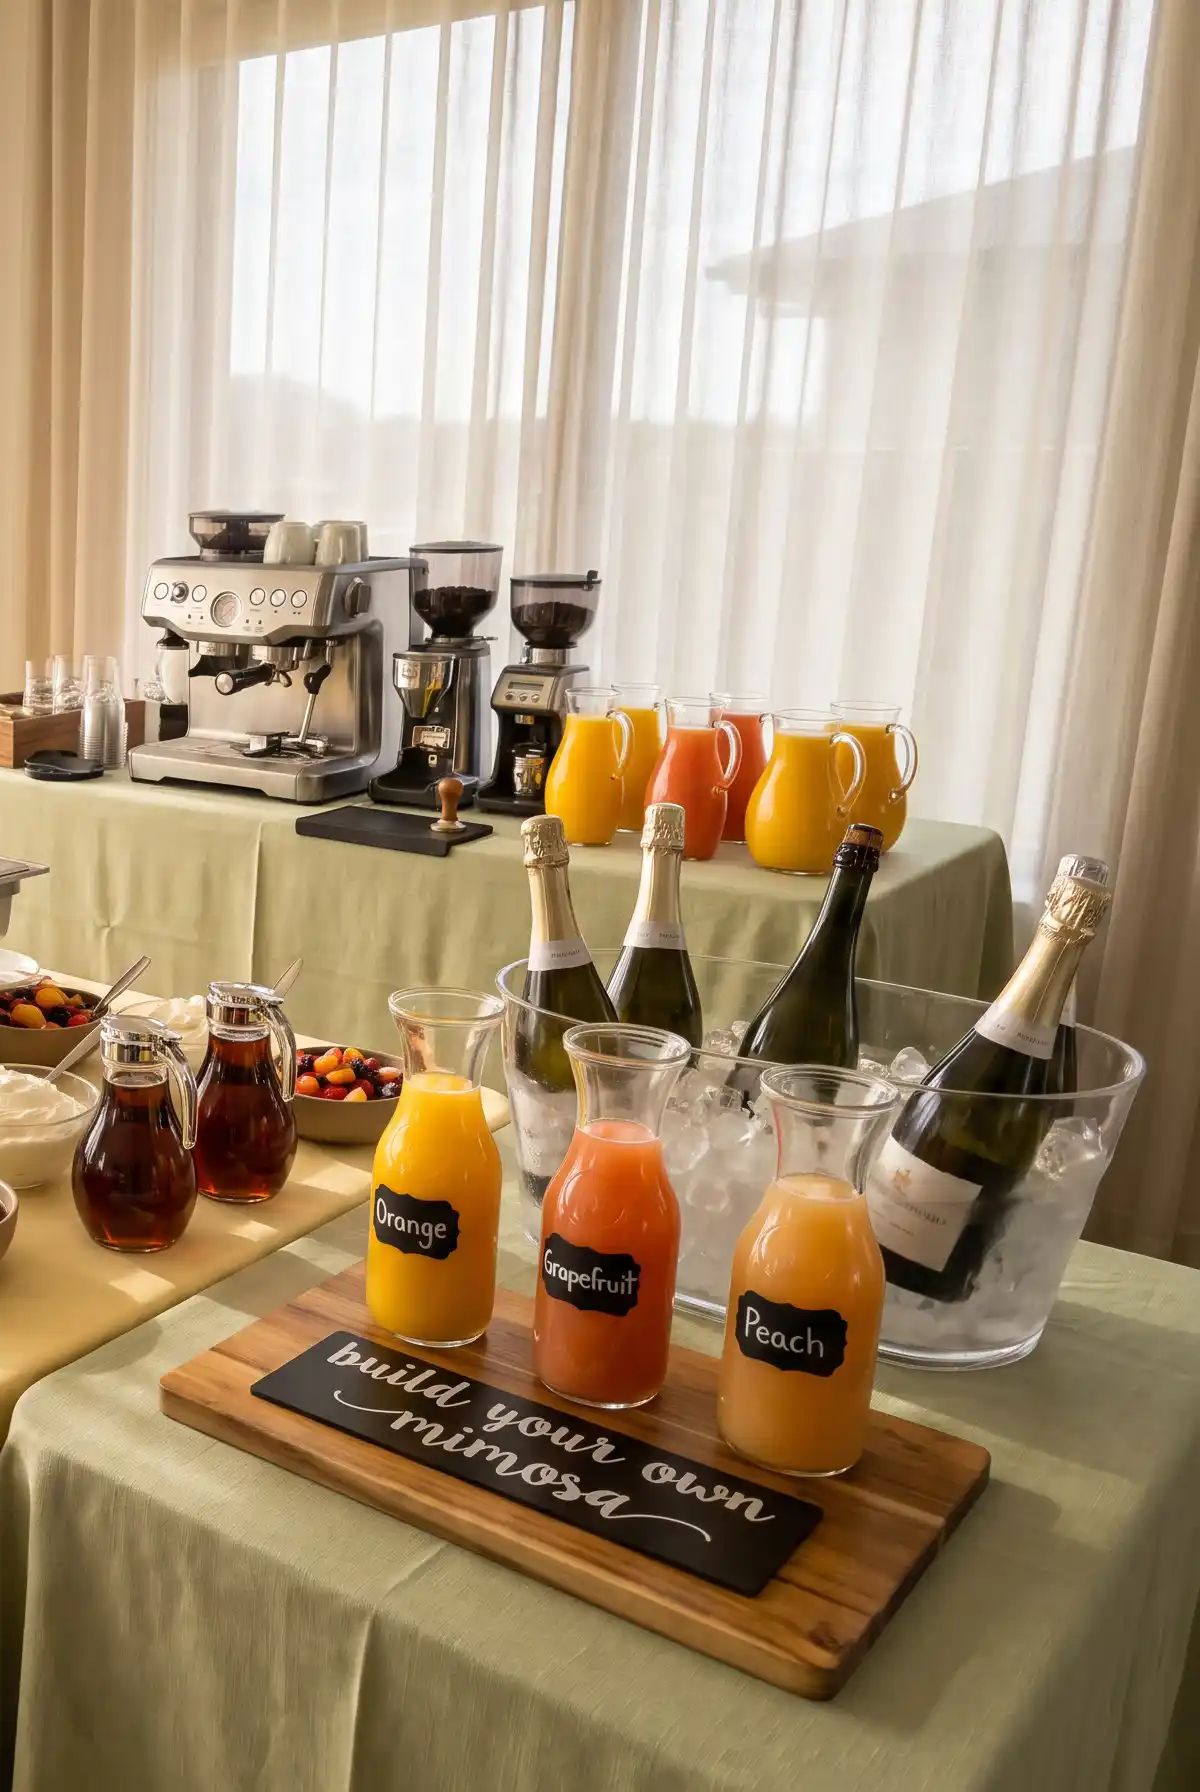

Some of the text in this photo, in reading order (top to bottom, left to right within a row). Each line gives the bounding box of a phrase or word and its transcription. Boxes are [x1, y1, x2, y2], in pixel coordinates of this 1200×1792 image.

[376, 1197, 447, 1250] Orange
[544, 1248, 638, 1295] Grapefruit
[745, 1306, 824, 1358] Peach
[326, 1341, 776, 1522] build your own
